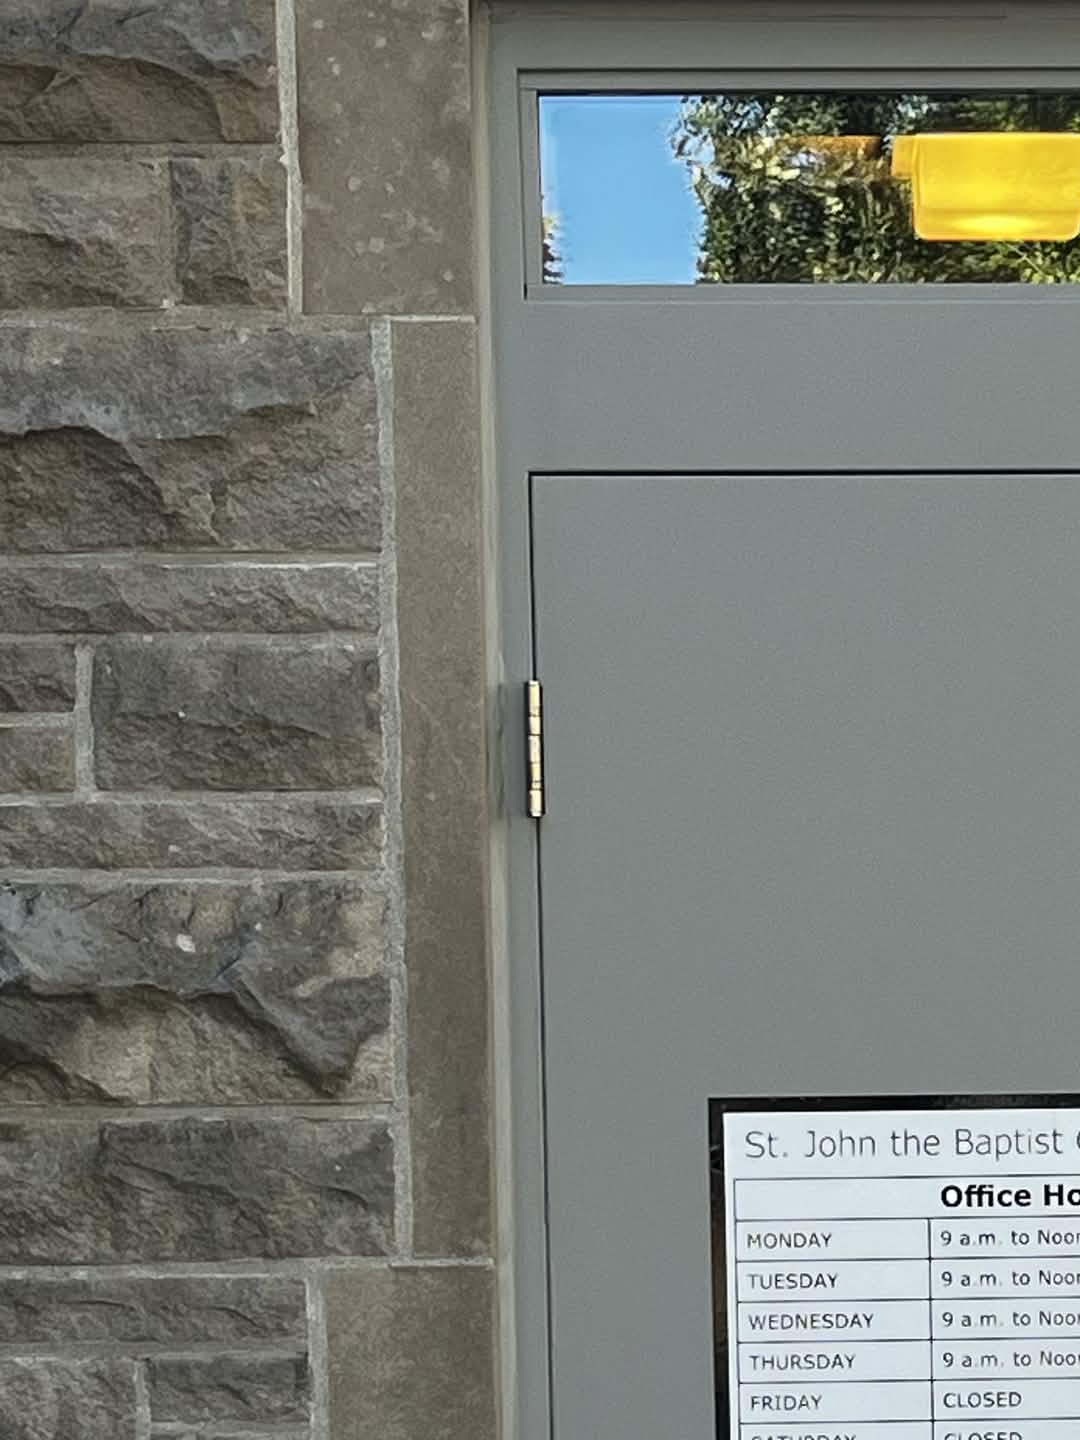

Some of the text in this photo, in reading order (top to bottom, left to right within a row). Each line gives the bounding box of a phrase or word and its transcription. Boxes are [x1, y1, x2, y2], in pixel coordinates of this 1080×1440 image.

[744, 1130, 789, 1159] St.
[804, 1129, 876, 1159] John
[889, 1127, 941, 1158] the
[954, 1127, 1065, 1163] Baptist
[940, 1183, 1032, 1208] Office
[746, 1231, 833, 1250] MONDAY
[939, 1229, 953, 1247] 9
[959, 1232, 1004, 1247] a.m.
[1010, 1229, 1030, 1247] to
[746, 1272, 839, 1291] TUESDAY
[940, 1270, 953, 1289] 9
[960, 1272, 1004, 1288] a.m.
[1011, 1271, 1031, 1287] to
[747, 1312, 875, 1331] WEDNESDAY
[941, 1311, 954, 1328] 9
[960, 1313, 1005, 1328] a.m.
[1012, 1311, 1032, 1327] to
[748, 1353, 857, 1371] THURSDAY
[942, 1351, 955, 1369] 9
[961, 1354, 1006, 1368] a.m.
[1012, 1351, 1033, 1368] to
[750, 1394, 823, 1412] FRIDAY
[942, 1391, 1023, 1409] CLOSED
